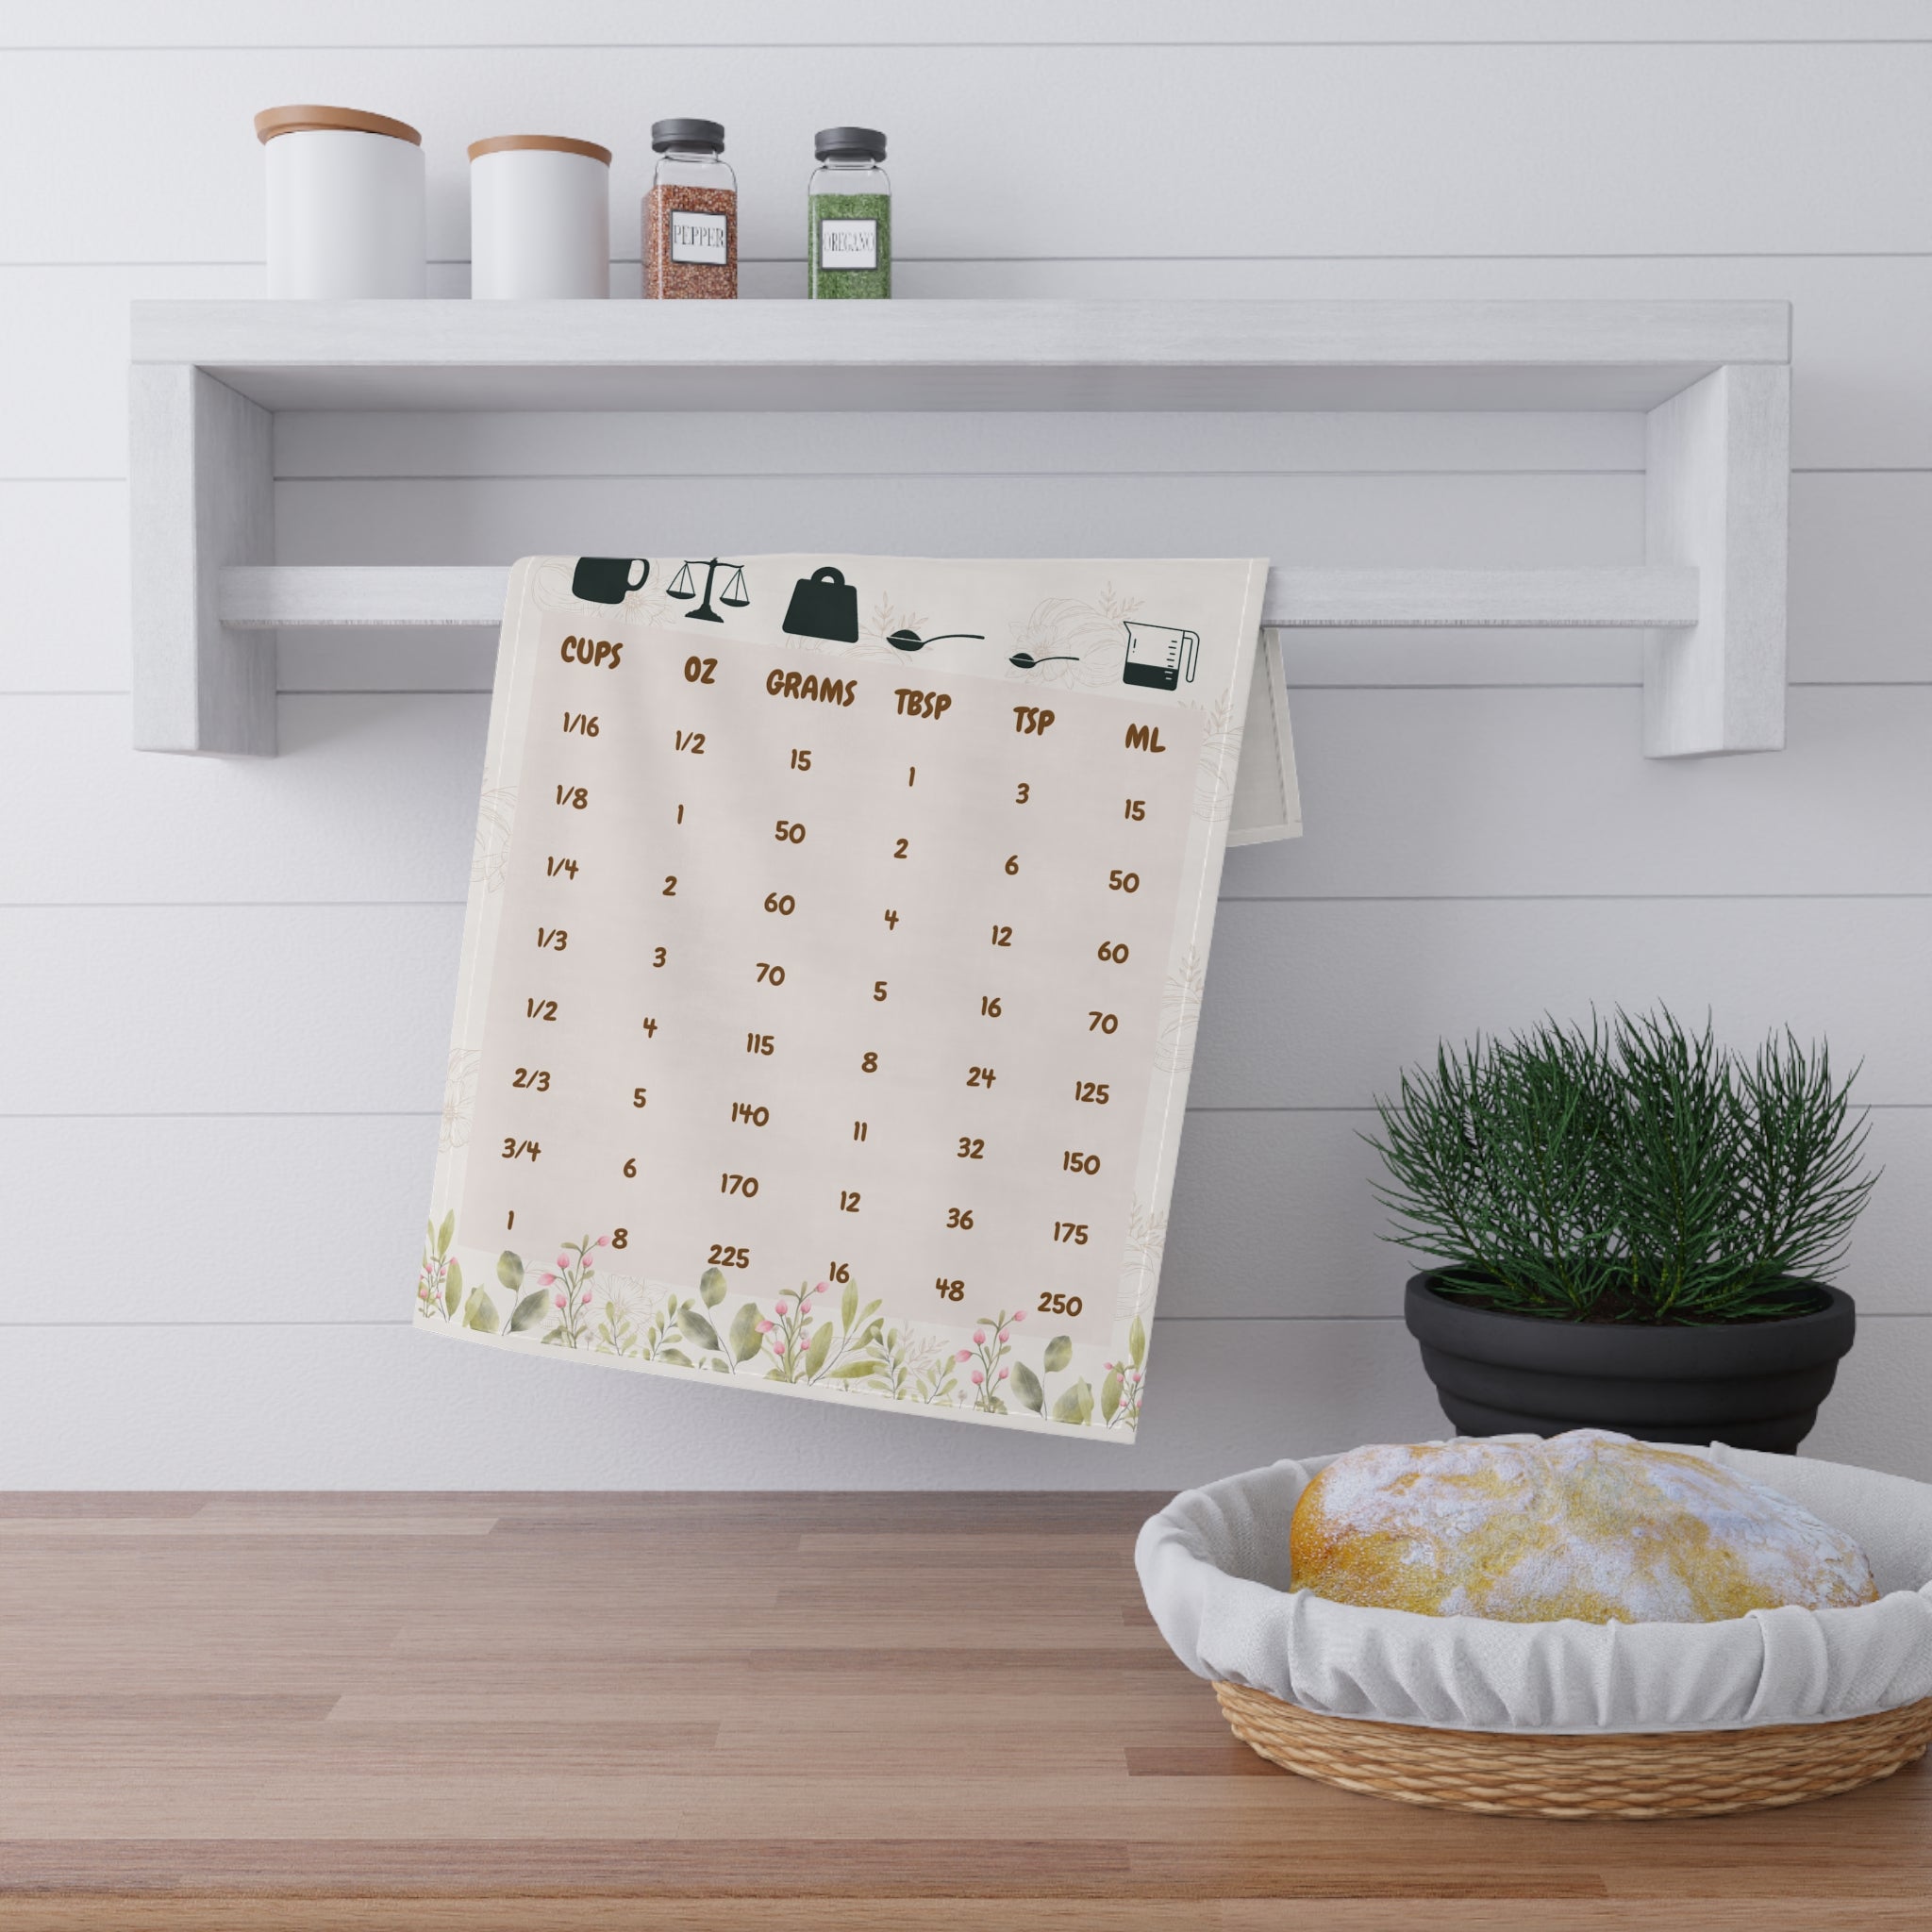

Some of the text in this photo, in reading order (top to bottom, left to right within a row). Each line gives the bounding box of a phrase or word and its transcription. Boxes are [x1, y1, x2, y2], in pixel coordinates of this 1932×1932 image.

[674, 225, 725, 248] PEPPER
[824, 232, 874, 253] OREGANO
[560, 635, 1167, 754] CUPS OZ GRAMS TBSP TSP ML
[563, 711, 1146, 822] 1/16 1/2 15 1 3 15
[556, 784, 1141, 894] 1/8 1 50 2 6 50
[546, 856, 1130, 965] 1/4 2 60 4 12 60
[537, 926, 1119, 1035] 1/3 3 70 5 16 70
[526, 997, 1110, 1106] 1/2 4 115 8 24 125
[512, 1067, 1101, 1176] 2/3 5 140 11 32 150
[501, 1137, 1090, 1246] 3/4 6 170 12 36 175
[507, 1209, 1083, 1318] 1 8 225 16 48 250
